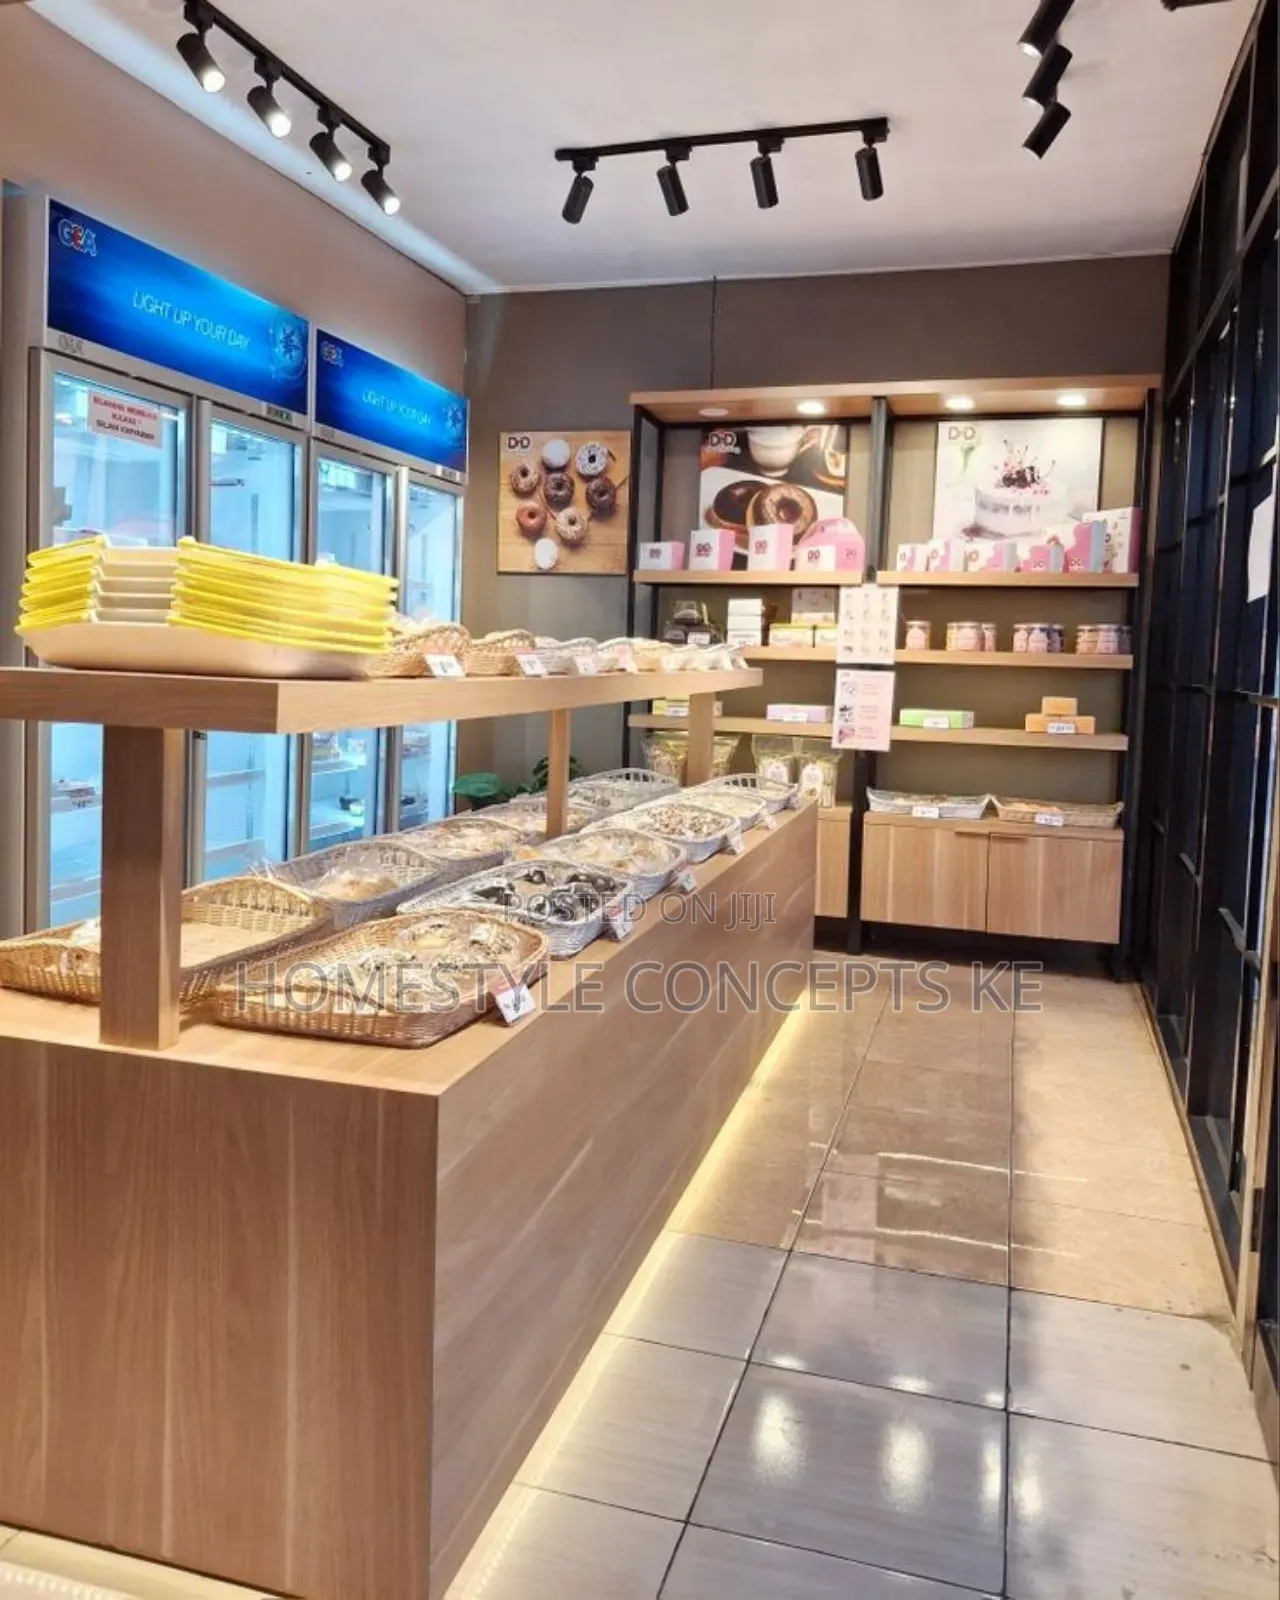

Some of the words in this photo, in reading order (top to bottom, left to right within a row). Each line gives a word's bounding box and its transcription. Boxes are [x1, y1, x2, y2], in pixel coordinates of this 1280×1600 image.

[173, 308, 192, 327] UP
[193, 314, 227, 342] YOUR
[227, 328, 251, 350] DAY
